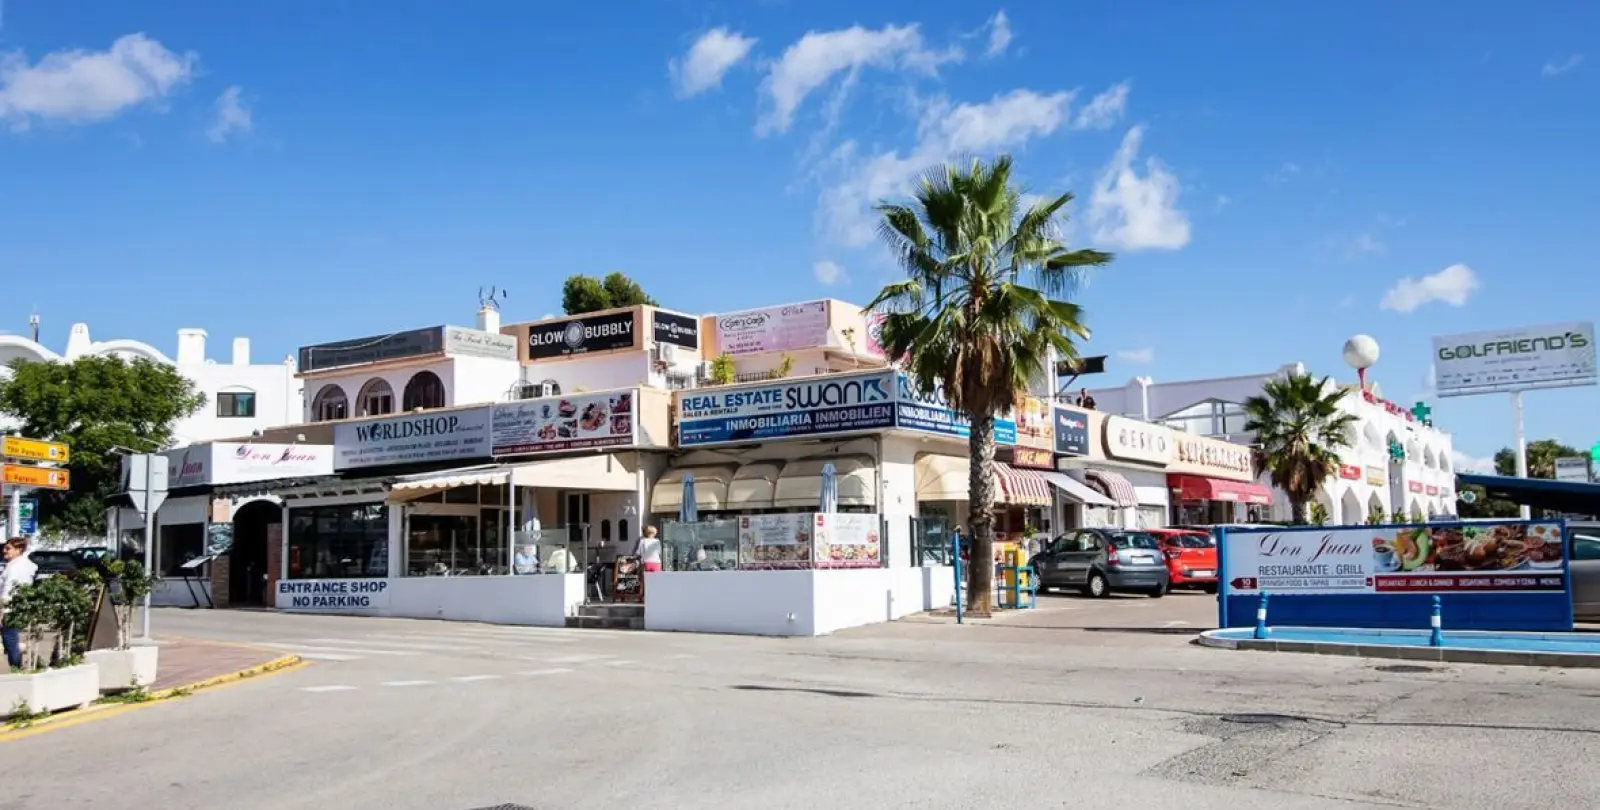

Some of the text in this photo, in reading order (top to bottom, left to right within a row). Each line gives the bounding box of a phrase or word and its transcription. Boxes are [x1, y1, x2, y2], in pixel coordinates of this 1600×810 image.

[529, 321, 632, 346] GLOW BUBBLY
[1438, 331, 1588, 360] GOLFRIEND'S
[682, 395, 720, 411] REAL
[724, 388, 782, 405] ESTATE
[356, 415, 458, 443] WORLDSHOP
[726, 413, 812, 432] INMOBILIARIA
[815, 406, 891, 423] INMOBILIEN
[234, 444, 276, 461] Don
[1258, 533, 1363, 562] Don Juan
[1259, 563, 1364, 576] RESTAURANTE GRILL
[280, 581, 387, 593] ENTRANCE SHOP
[292, 595, 370, 607] NO PARKING
